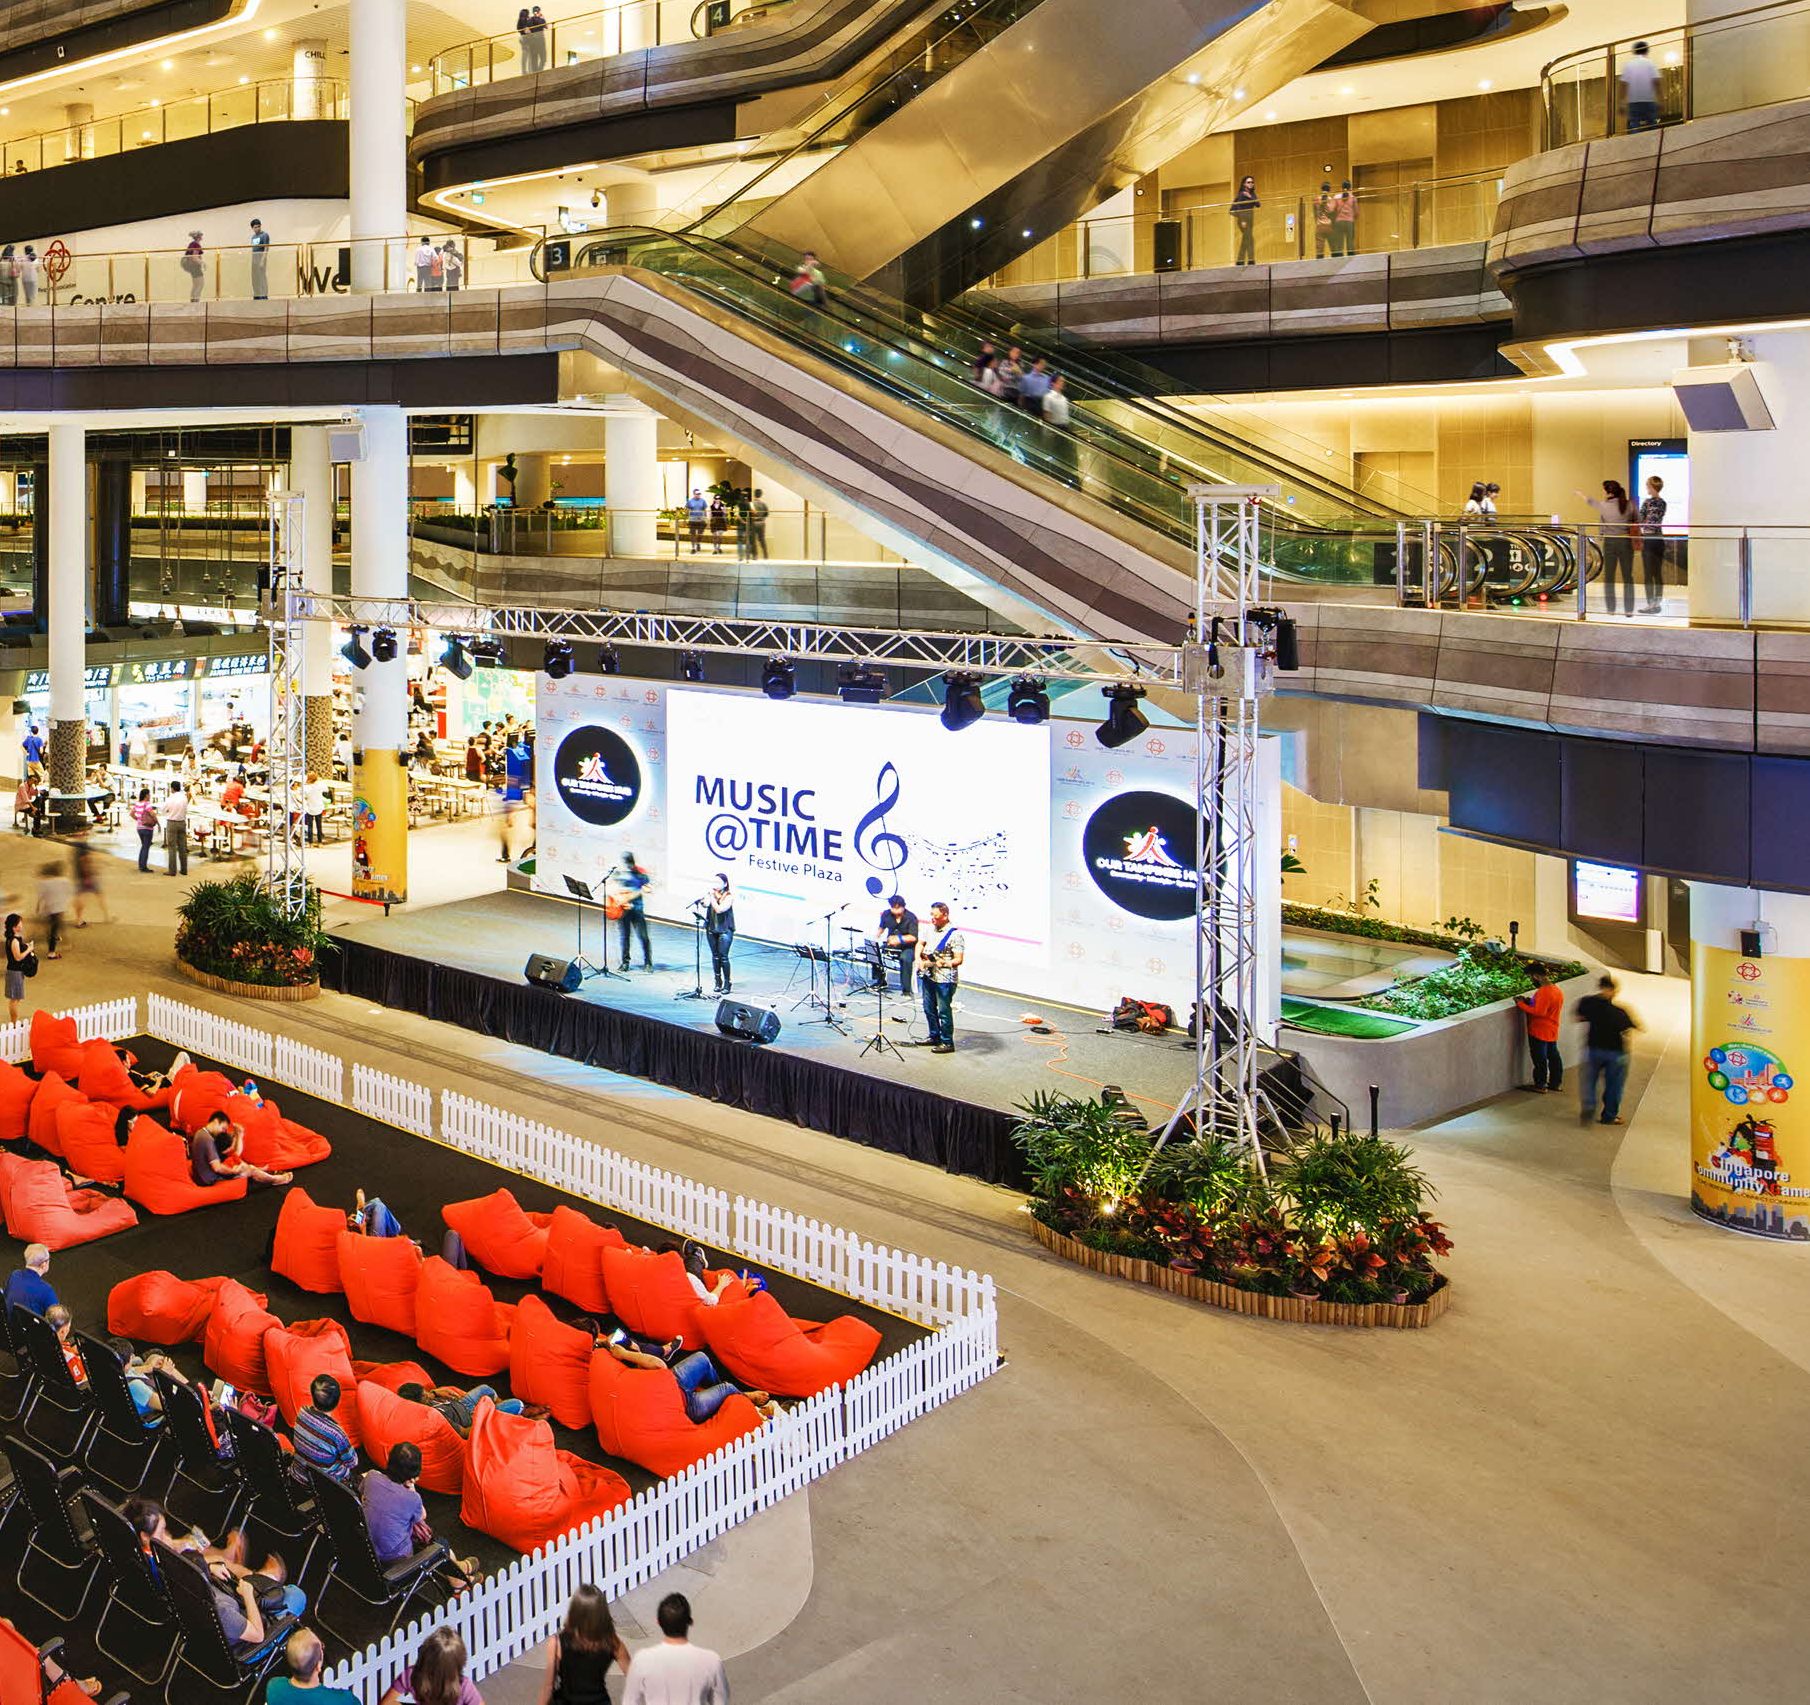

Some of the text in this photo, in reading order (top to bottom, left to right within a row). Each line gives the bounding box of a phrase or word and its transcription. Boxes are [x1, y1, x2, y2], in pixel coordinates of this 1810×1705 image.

[711, 6, 723, 22] 4
[552, 247, 562, 265] 3
[695, 774, 816, 821] MUSIC
[705, 813, 843, 862] @TIME
[748, 854, 842, 883] Festive Plaza
[1096, 857, 1123, 871] OUR
[1711, 1155, 1791, 1183] Singapore
